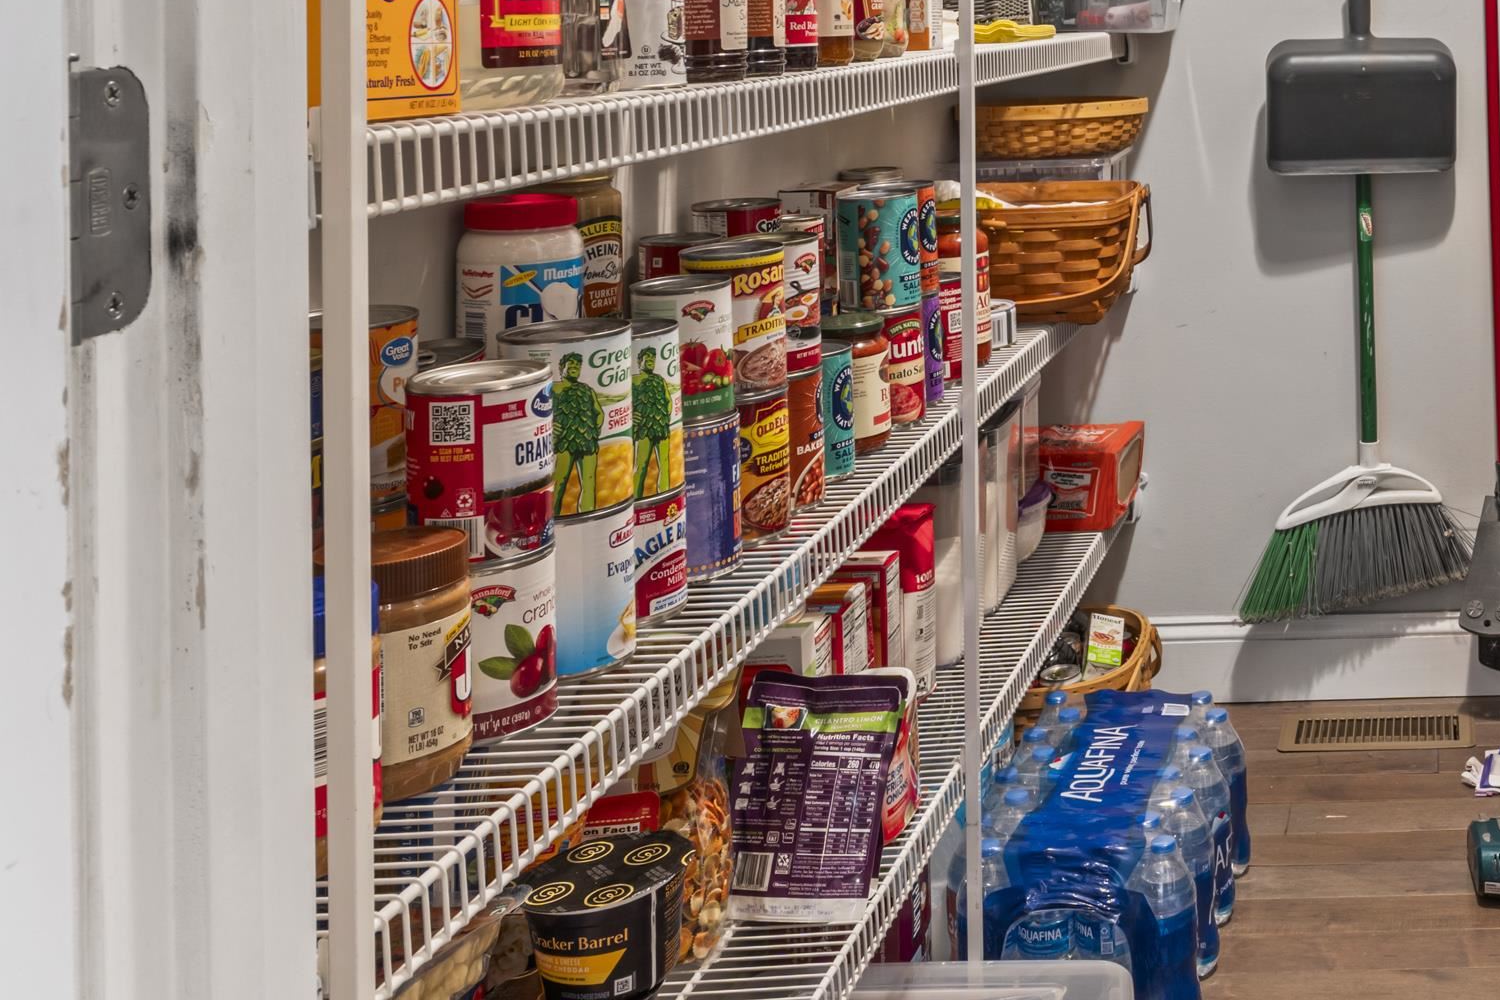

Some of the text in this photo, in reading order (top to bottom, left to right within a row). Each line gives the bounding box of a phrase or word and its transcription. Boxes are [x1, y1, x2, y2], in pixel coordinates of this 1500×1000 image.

[510, 18, 531, 26] LIGHT
[790, 21, 806, 31] Red
[634, 62, 648, 70] NET
[396, 76, 416, 87] Fresh
[586, 243, 619, 262] HEINZ
[588, 287, 618, 300] TURKEY
[591, 296, 618, 310] GRAVY
[386, 344, 410, 357] Great
[756, 423, 774, 438] OLD
[760, 460, 783, 474] Refried
[667, 572, 684, 586] Milk
[422, 628, 442, 639] Need
[408, 639, 433, 651] To Stir
[502, 715, 510, 725] OZ
[511, 711, 531, 724] (397g)
[408, 732, 419, 745] NET
[420, 730, 429, 741] WT
[437, 726, 444, 735] OZ
[811, 760, 836, 768] Calories
[847, 760, 860, 769] 260
[1060, 724, 1138, 802] AQUAFINA
[603, 824, 639, 834] Facts
[532, 928, 628, 951] Cracker Barrel
[1017, 925, 1063, 944] AQUAFINA
